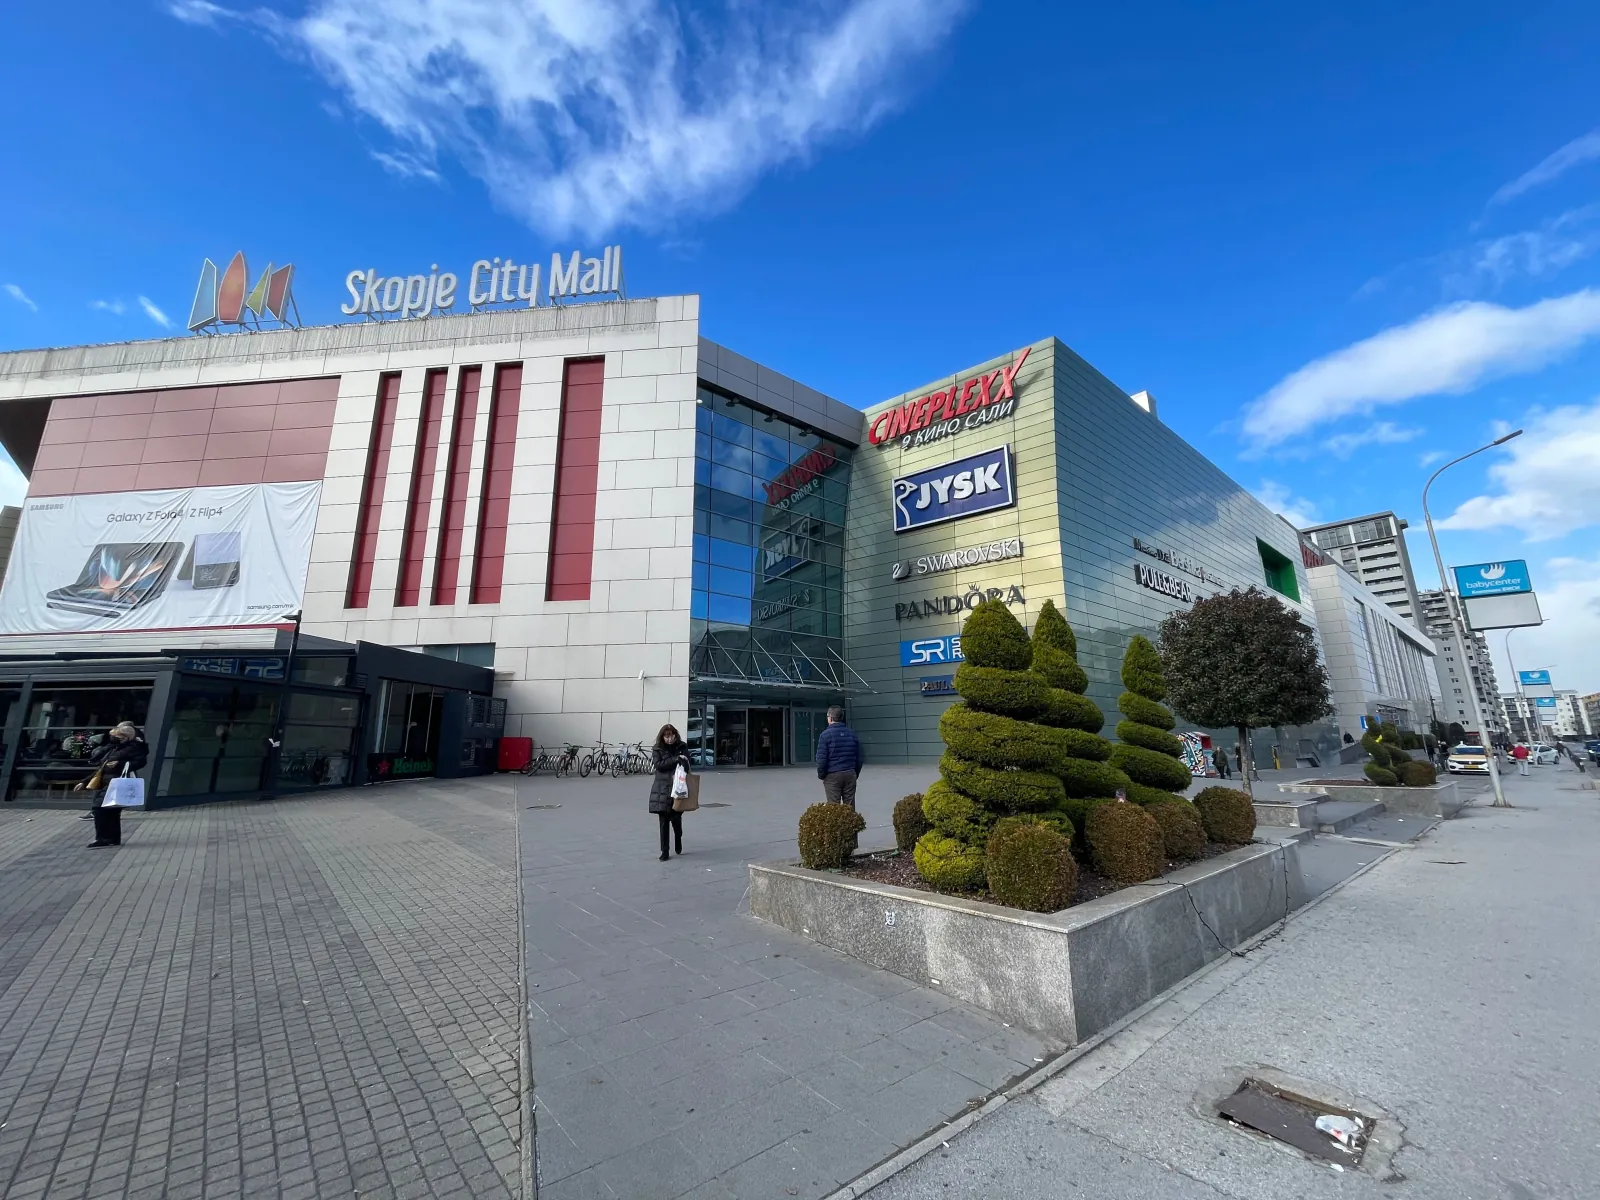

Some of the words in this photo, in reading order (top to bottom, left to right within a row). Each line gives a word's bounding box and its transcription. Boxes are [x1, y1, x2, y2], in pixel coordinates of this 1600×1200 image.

[341, 264, 457, 319] Skopje
[469, 257, 540, 307] City
[549, 245, 620, 298] Mall
[868, 347, 1032, 445] CINEPLEXX
[902, 434, 911, 449] 9
[914, 418, 960, 445] КИНО
[964, 400, 1014, 427] САЛИ
[916, 462, 1002, 509] JYSK
[30, 503, 64, 511] SAMSUNG
[106, 512, 145, 523] Galaxy
[146, 511, 154, 521] Z
[190, 508, 196, 518] Z
[198, 506, 223, 517] Flip4
[917, 537, 1021, 574] SWAROVSKI
[1139, 563, 1193, 603] PULL&BEAR
[1465, 578, 1521, 589] babycenter
[909, 639, 945, 664] SR
